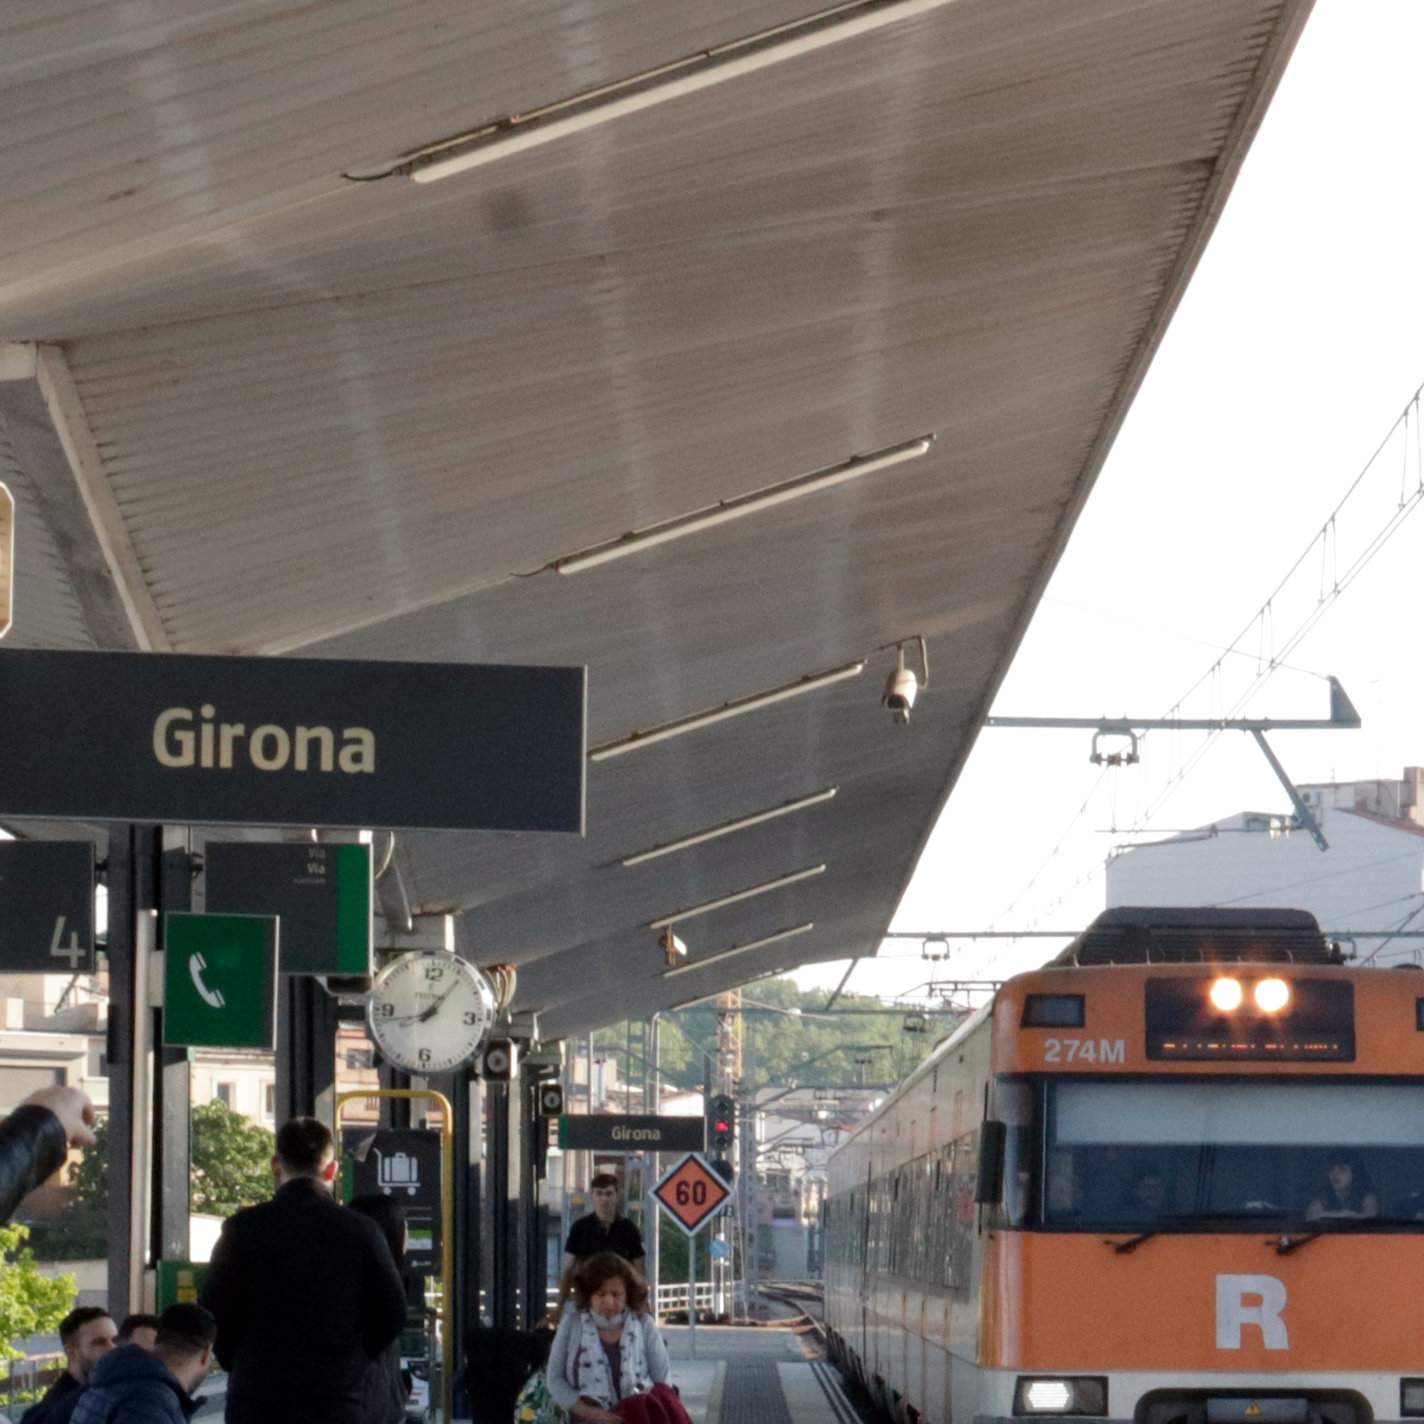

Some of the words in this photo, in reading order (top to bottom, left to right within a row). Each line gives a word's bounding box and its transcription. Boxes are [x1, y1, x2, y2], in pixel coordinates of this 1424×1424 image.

[152, 703, 376, 774] Girona
[49, 915, 87, 969] 4
[425, 967, 444, 981] 12
[381, 1003, 394, 1017] 9
[463, 1012, 476, 1026] 3
[418, 1047, 432, 1062] 6
[1044, 1038, 1125, 1064] 274M
[611, 1126, 661, 1141] Girona
[676, 1180, 707, 1206] 60
[1215, 1273, 1290, 1351] R
